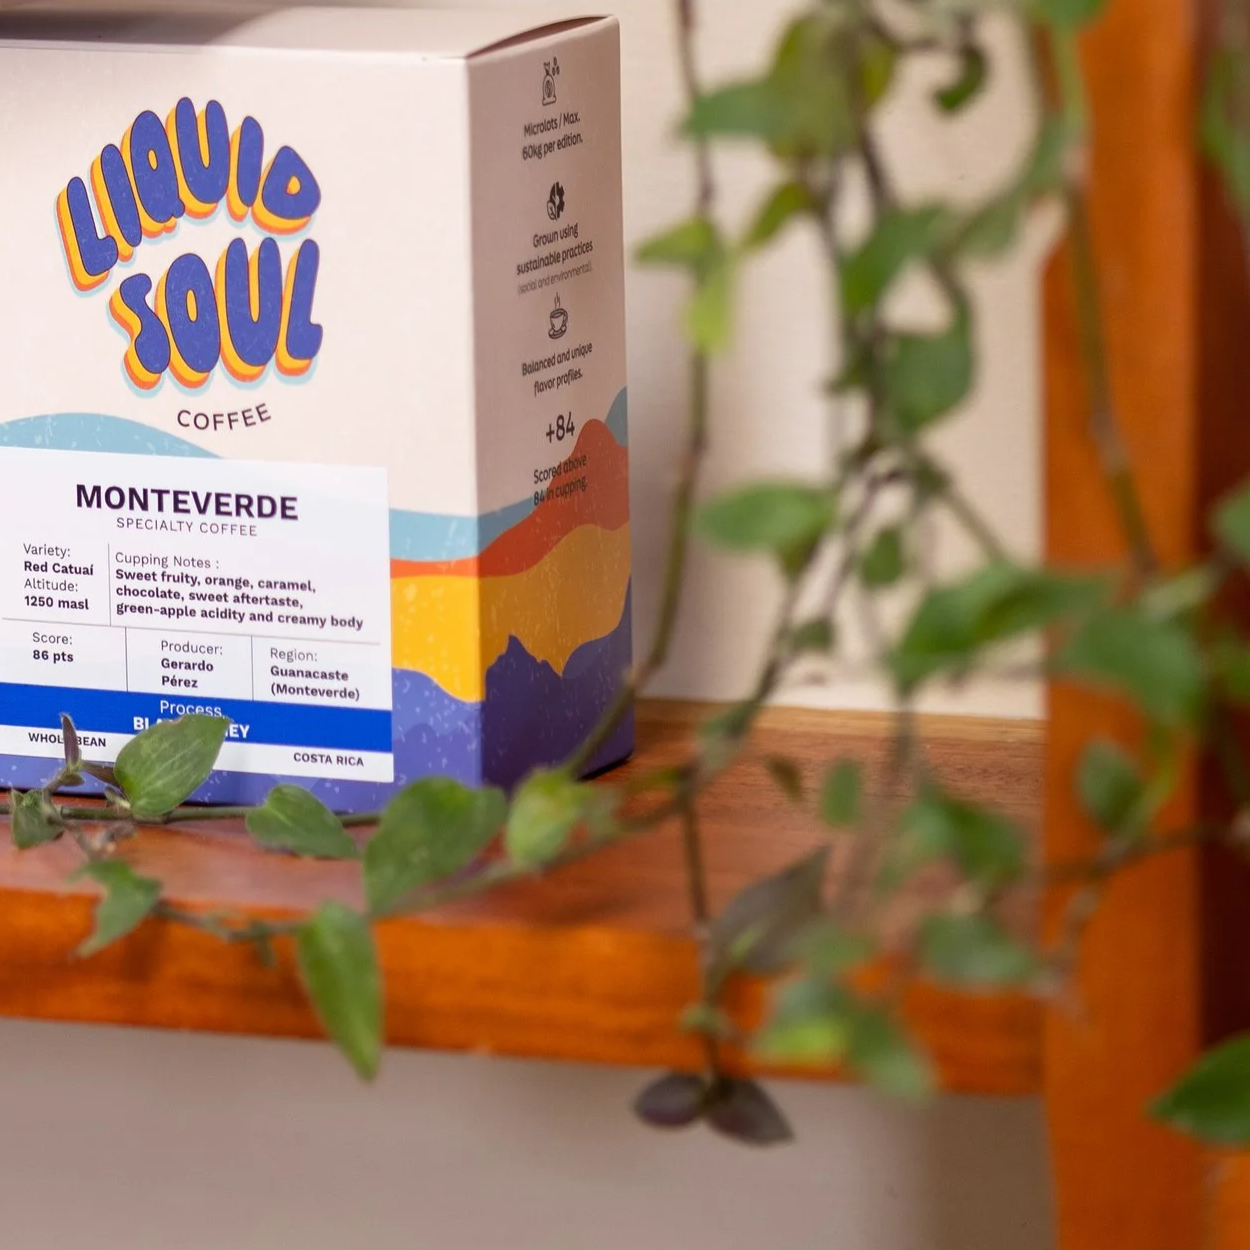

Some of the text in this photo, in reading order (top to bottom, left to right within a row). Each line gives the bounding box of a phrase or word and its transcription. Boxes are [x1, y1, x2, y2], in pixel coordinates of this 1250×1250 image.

[523, 117, 558, 138] Microlots
[563, 111, 581, 127] Max.
[522, 132, 583, 160] 60kg per edition.
[55, 96, 321, 295] LIQUID
[533, 222, 578, 248] Grown using
[517, 241, 593, 276] sustainable practices
[108, 237, 323, 395] SOUL
[522, 342, 593, 376] Balanced and unique
[534, 367, 583, 397] flavor profiles.
[177, 403, 272, 431] COFFEE
[546, 411, 575, 443] +84
[533, 454, 587, 485] Scored above
[76, 483, 299, 521] MONTEVERDE
[533, 490, 545, 507] 84
[546, 488, 554, 501] in
[116, 517, 258, 537] SPECIALTY COFFEE
[23, 542, 71, 559] Variety:
[115, 552, 169, 568] Cupping
[24, 561, 94, 576] Red Catuaí
[24, 577, 78, 592] Altitude:
[115, 569, 316, 594] Sweet fruity, orange, caramel,
[25, 595, 89, 610] 1250 masl
[116, 585, 303, 609] chocolate, sweet aftertaste,
[116, 603, 364, 631] green-apple acidity and creamy body
[32, 631, 73, 646] Score:
[160, 639, 223, 656] Producer:
[32, 649, 74, 665] 86 pts
[160, 657, 214, 673] Gerardo
[270, 647, 318, 664] Region:
[161, 673, 198, 689] Pérez
[270, 664, 349, 683] Guanacaste
[270, 681, 361, 702] (Monteverde)
[160, 699, 222, 717] Process
[28, 732, 106, 748] WHOL BEAN
[293, 752, 364, 767] COSTA RICA
